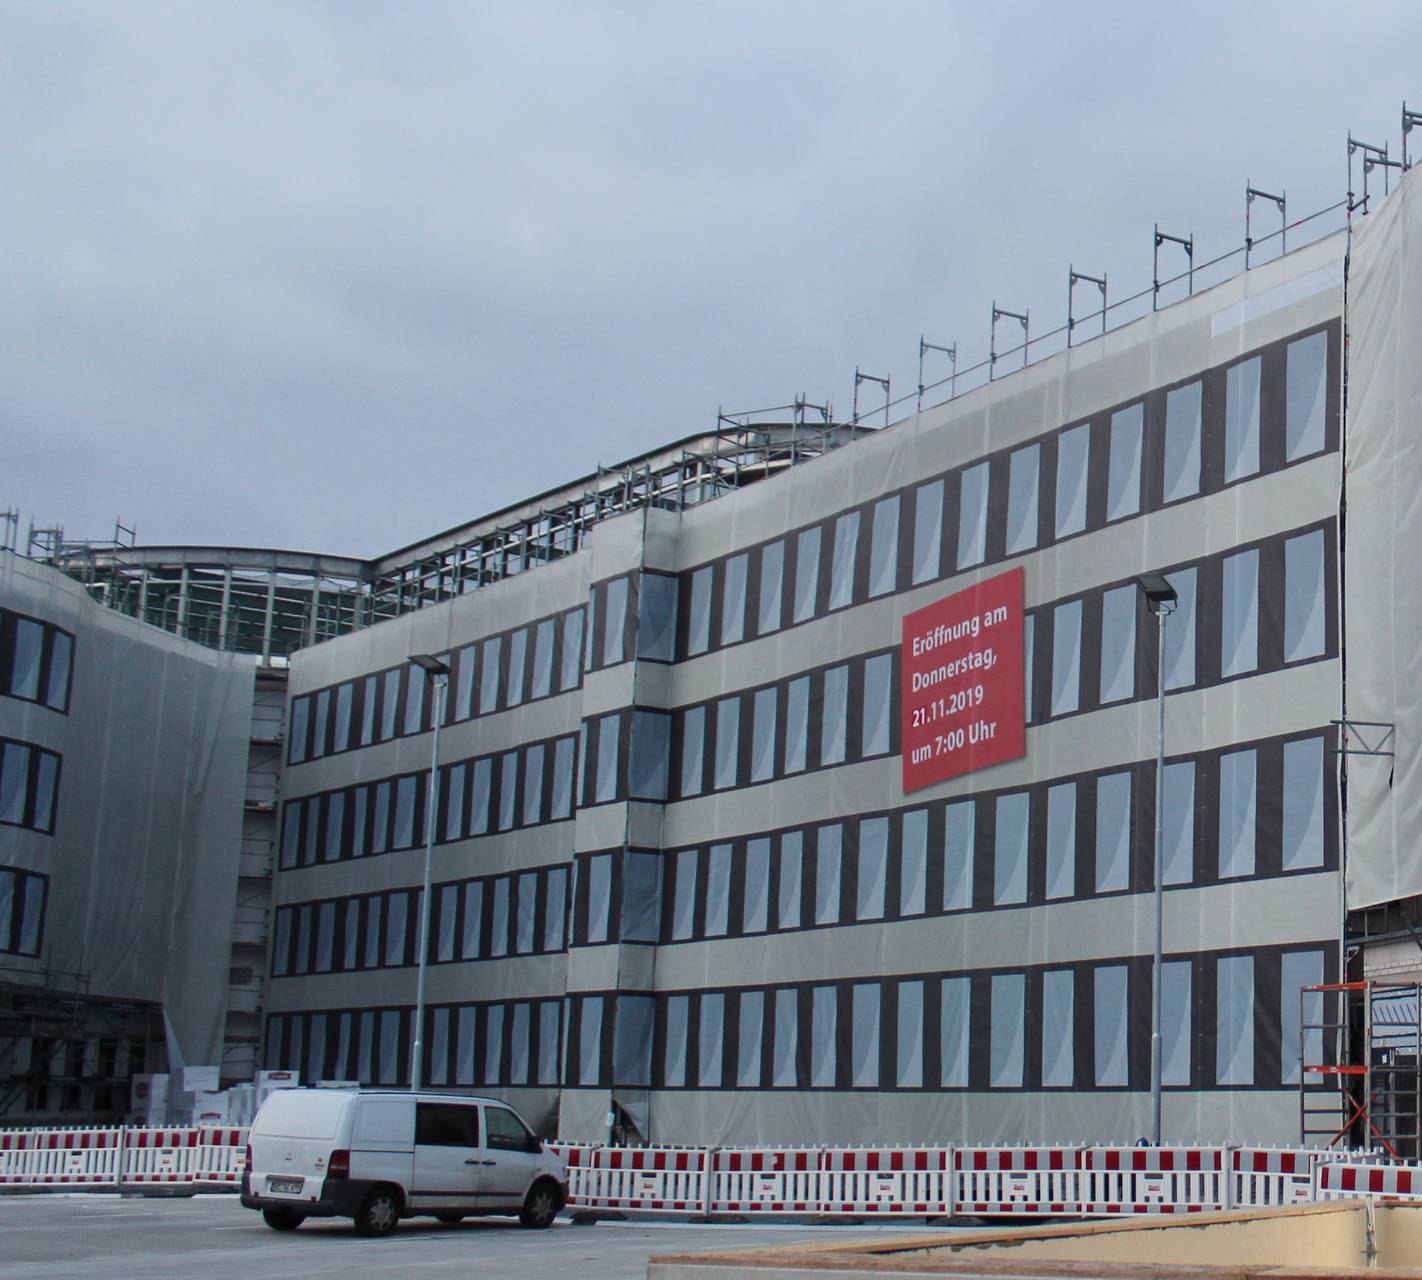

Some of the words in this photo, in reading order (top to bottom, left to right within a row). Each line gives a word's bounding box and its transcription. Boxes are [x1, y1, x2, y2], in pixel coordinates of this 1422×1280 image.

[912, 616, 980, 657] Eröffnung
[984, 606, 1007, 627] am
[912, 648, 997, 692] Donnerstag,
[912, 685, 984, 728] 21.11.2019
[912, 744, 931, 764] um
[936, 728, 964, 756] 7:00
[969, 719, 997, 744] Uhr
